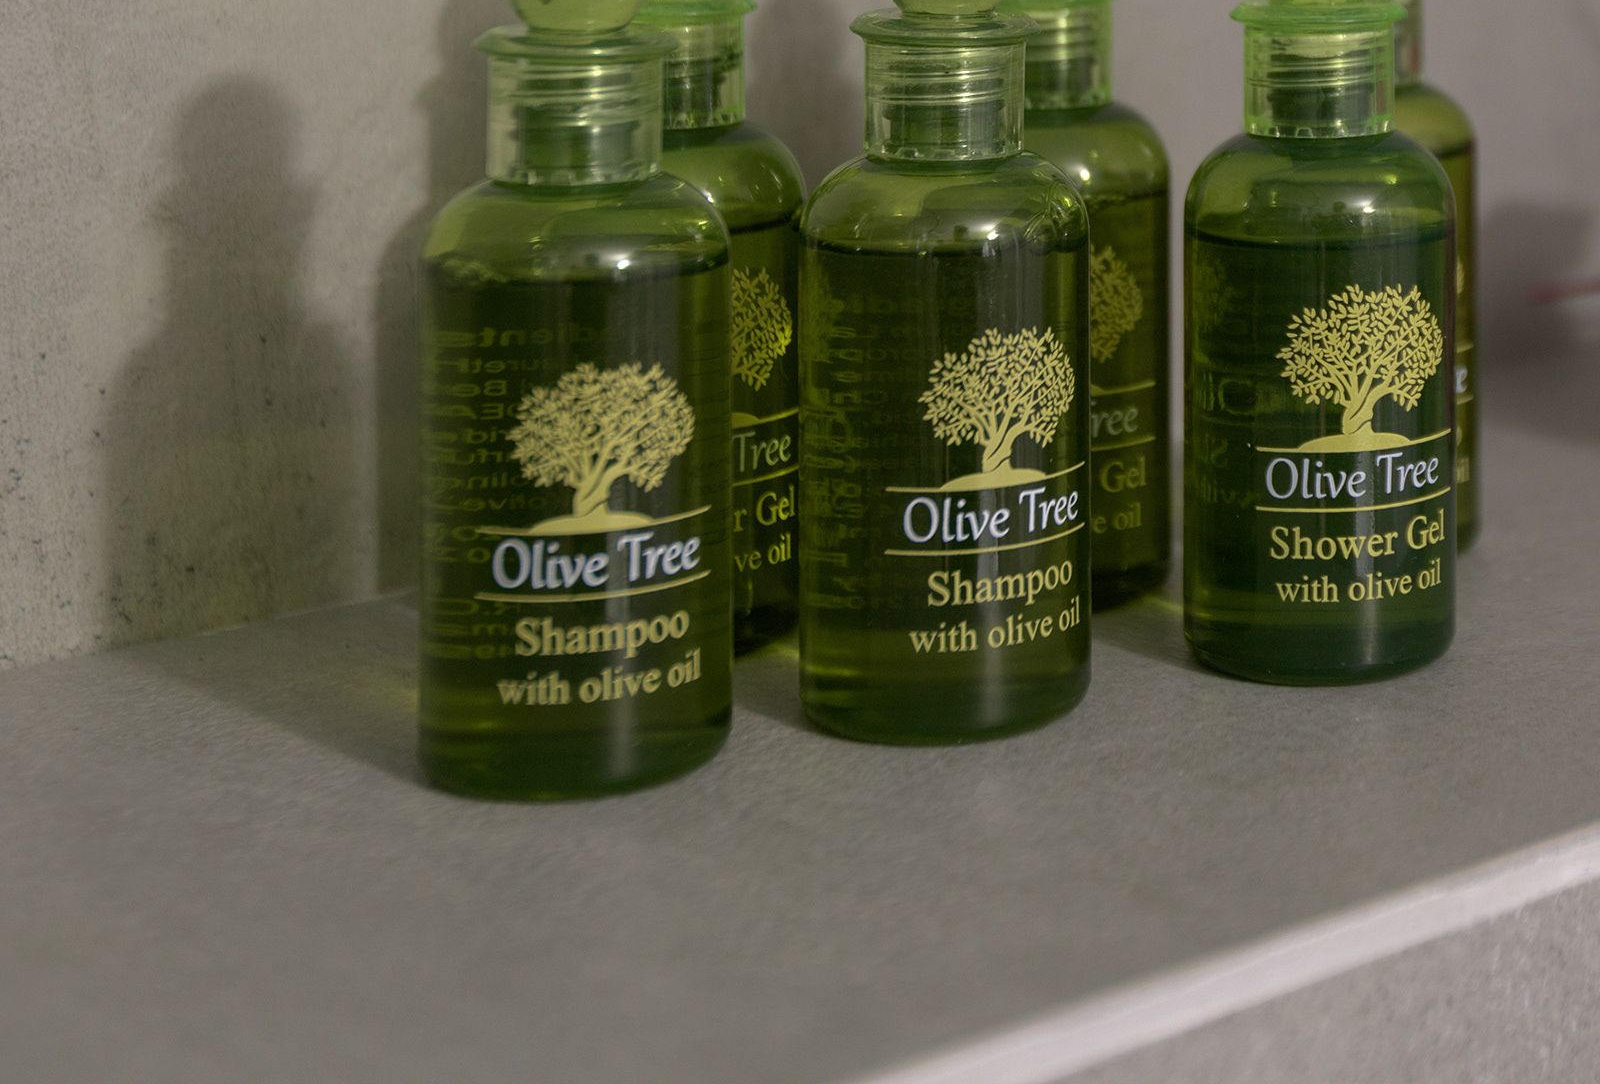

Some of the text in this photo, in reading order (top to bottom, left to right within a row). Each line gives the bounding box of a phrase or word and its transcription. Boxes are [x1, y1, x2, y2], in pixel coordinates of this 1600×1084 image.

[1090, 400, 1139, 438] ree
[731, 431, 792, 473] Tree
[1101, 455, 1147, 493] Gel
[1265, 456, 1367, 500] Olive
[1376, 452, 1440, 495] Tree
[755, 483, 796, 527] Gel
[902, 486, 1080, 544] Olive Tree
[1113, 500, 1143, 532] oil
[766, 531, 793, 565] oil
[1269, 508, 1446, 561] Shower Gel
[491, 537, 610, 591] Olive
[618, 531, 701, 584] Tree
[927, 558, 1073, 608] Shampoo
[1275, 558, 1442, 604] with olive oil
[513, 609, 690, 660] Shampoo
[908, 595, 1082, 655] with olive oil
[496, 648, 701, 707] with olive oil
